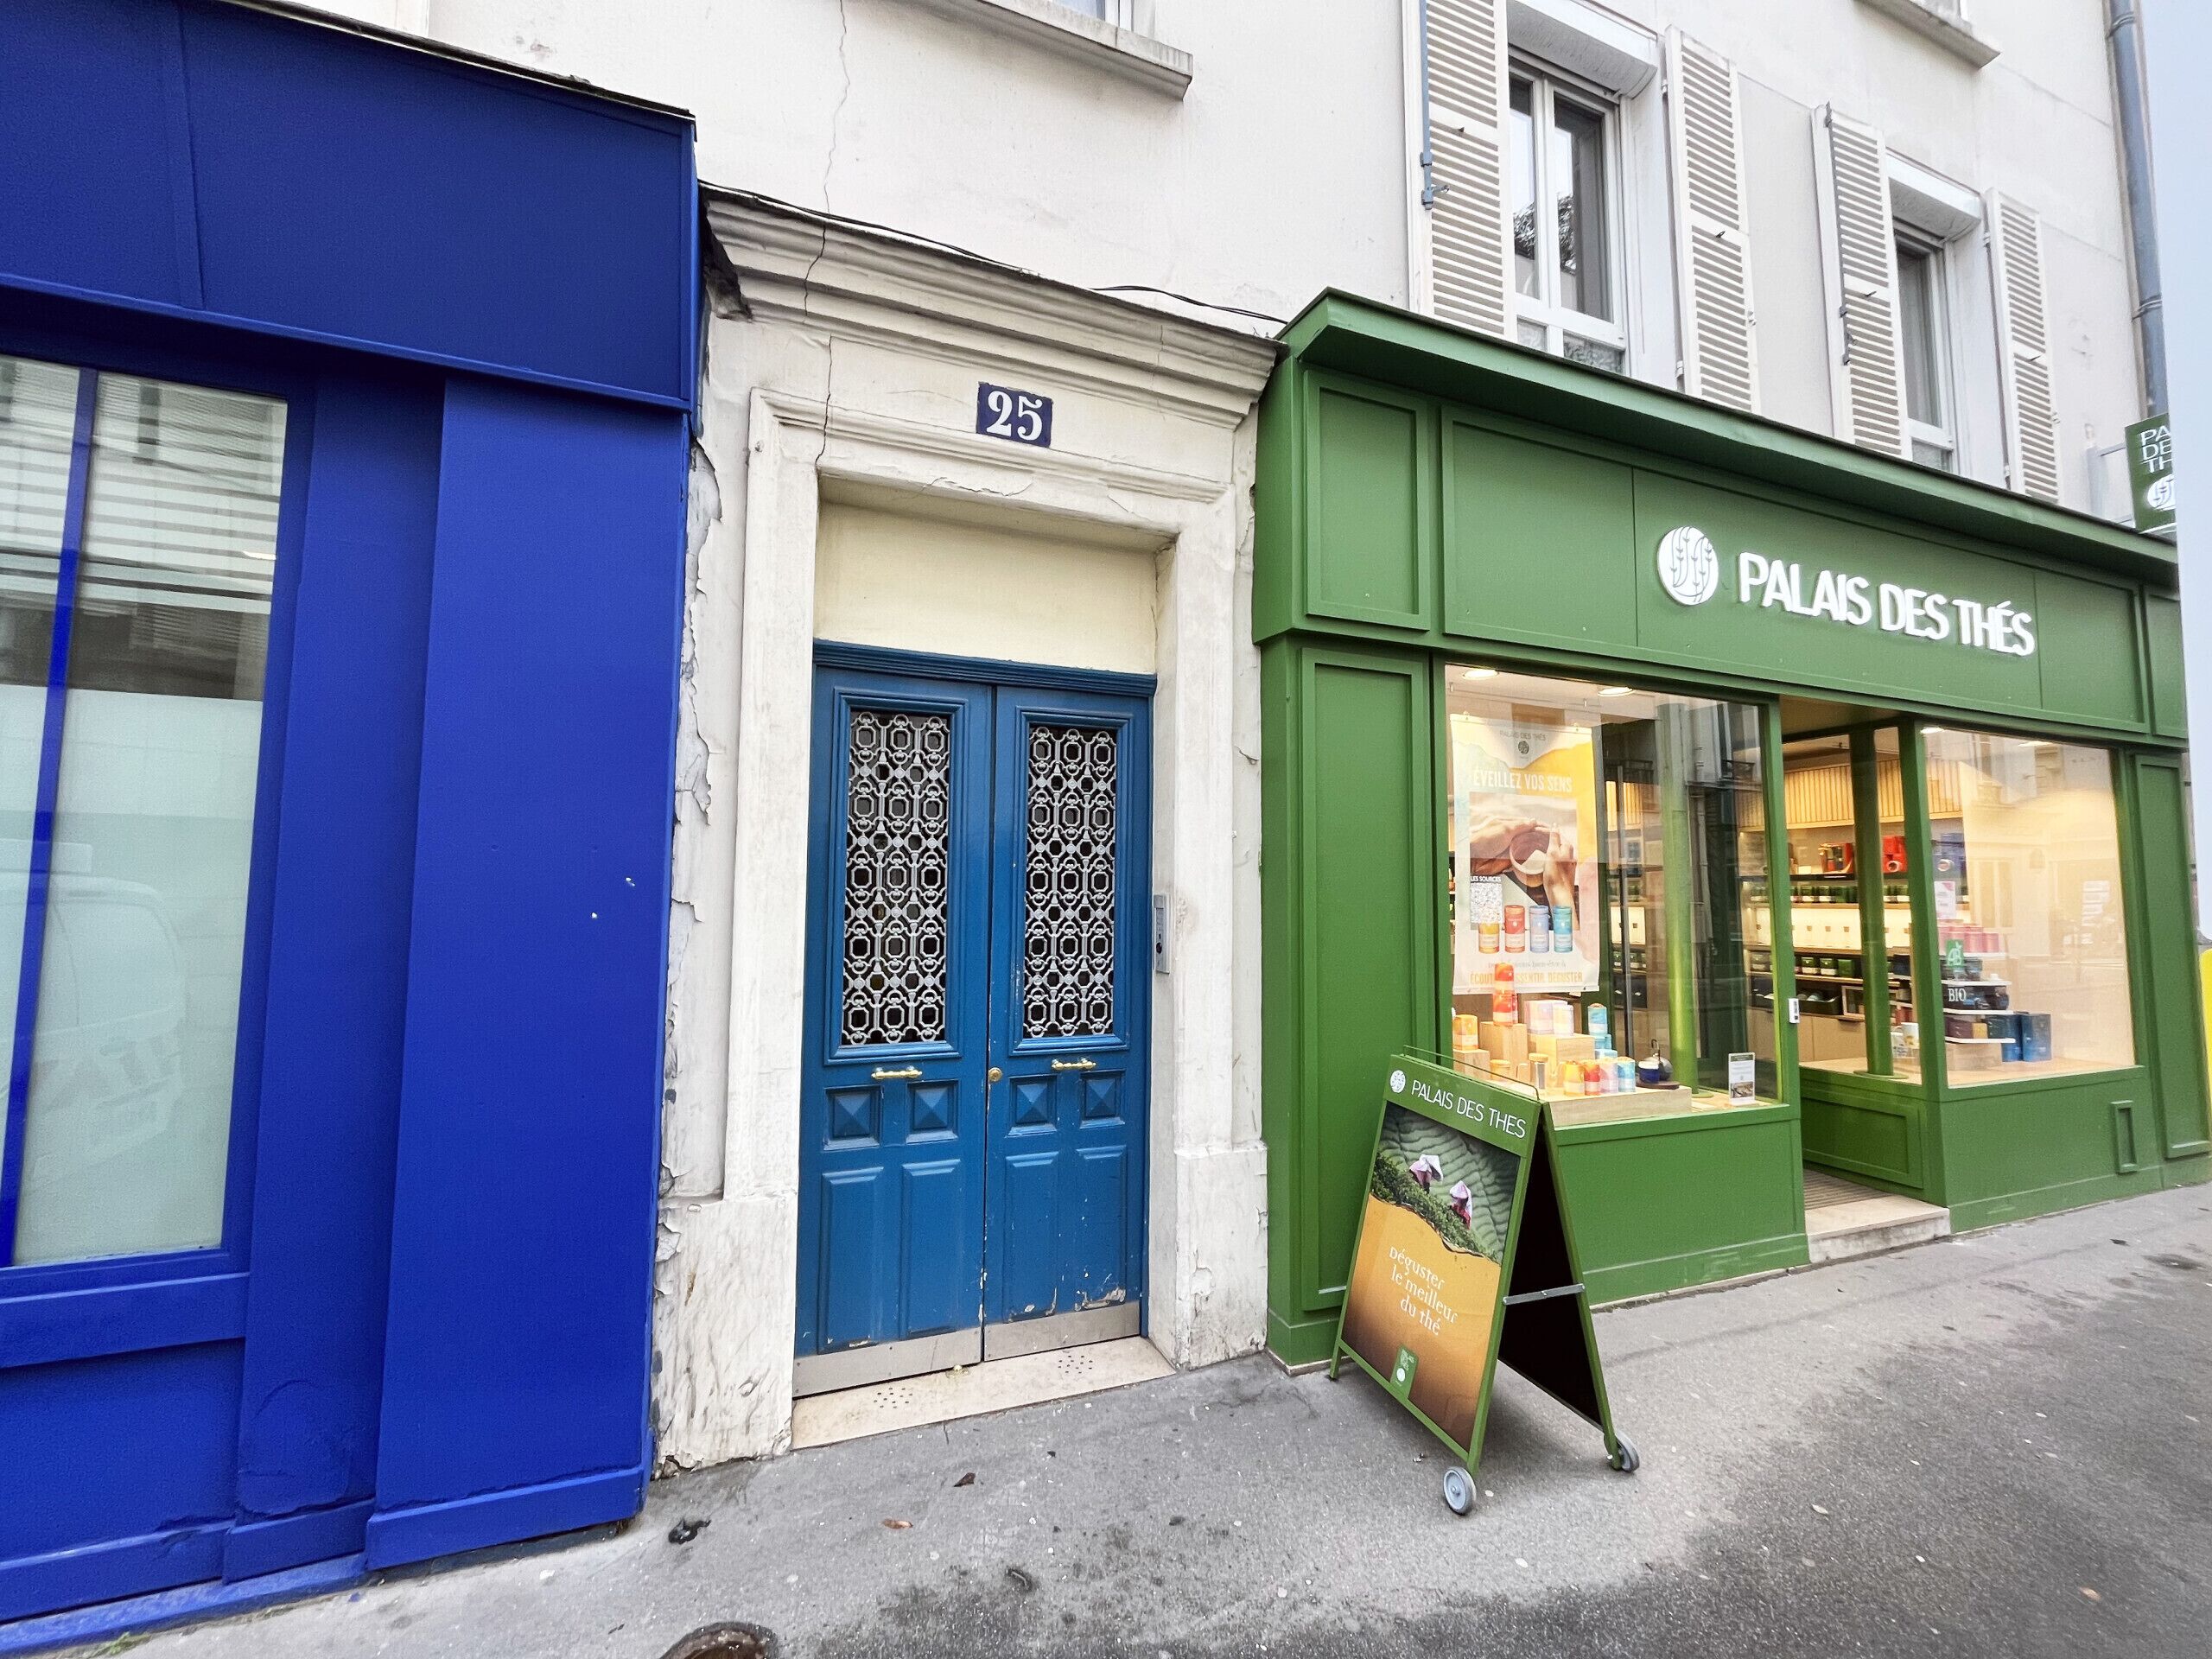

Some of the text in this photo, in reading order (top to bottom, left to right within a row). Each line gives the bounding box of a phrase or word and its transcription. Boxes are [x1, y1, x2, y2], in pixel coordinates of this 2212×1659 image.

[986, 391, 1043, 441] 25
[1738, 551, 2036, 657] PALAIS DES THÉS
[1473, 766, 1573, 793] ÉVEILLEZ VOS SENS
[1948, 988, 1966, 1002] BIO
[1411, 1079, 1526, 1139] PALAIS DES THES
[1389, 1246, 1445, 1290] Déguster
[1390, 1263, 1458, 1323] le meilleur
[1400, 1294, 1440, 1336] du thé
